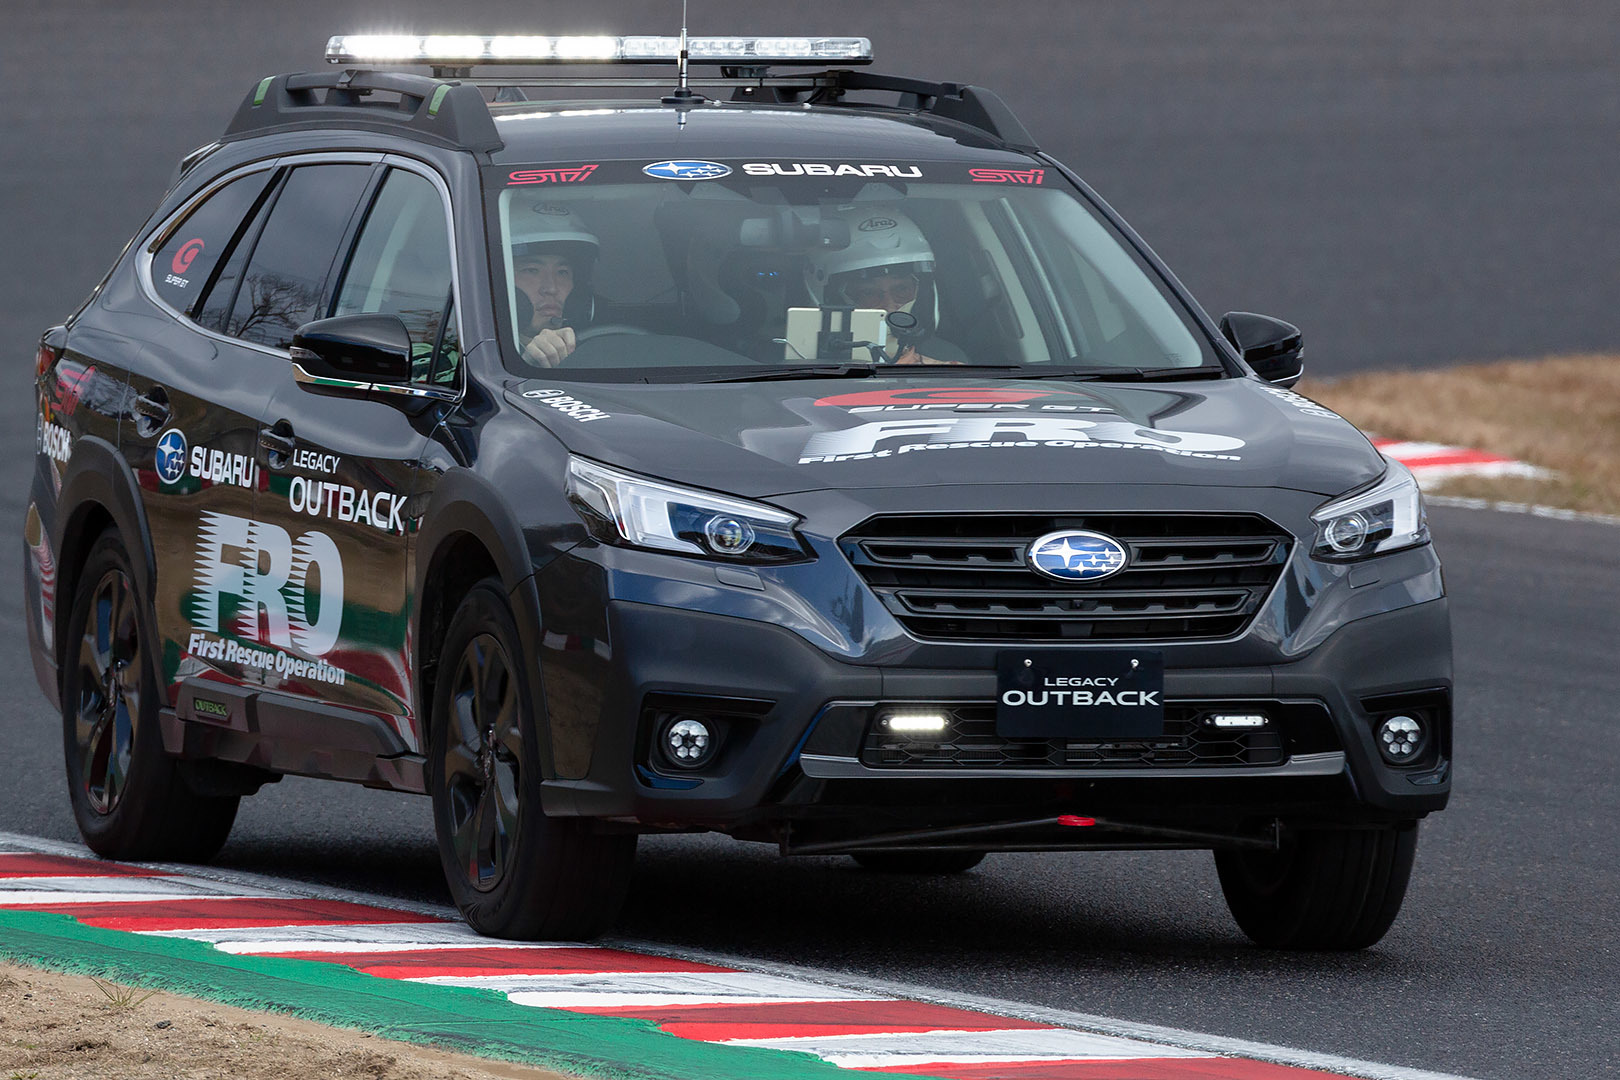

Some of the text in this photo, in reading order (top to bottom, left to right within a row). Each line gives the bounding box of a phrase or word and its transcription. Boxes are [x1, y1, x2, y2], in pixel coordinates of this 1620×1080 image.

[742, 163, 923, 178] SUBARU
[540, 396, 611, 423] BOSCH
[848, 403, 1114, 414] SUPER GT
[800, 417, 1246, 455] FRO
[293, 449, 340, 474] LEGACY
[798, 440, 1241, 464] First Rescue Operation
[190, 445, 254, 488] SUBARU
[289, 476, 407, 531] OUTBACK
[191, 510, 344, 656] FRO
[188, 633, 345, 686] First Rescue Operation
[1044, 677, 1119, 687] LEGACY
[194, 700, 227, 716] OUTBACK
[1002, 690, 1160, 706] OUTBACK
